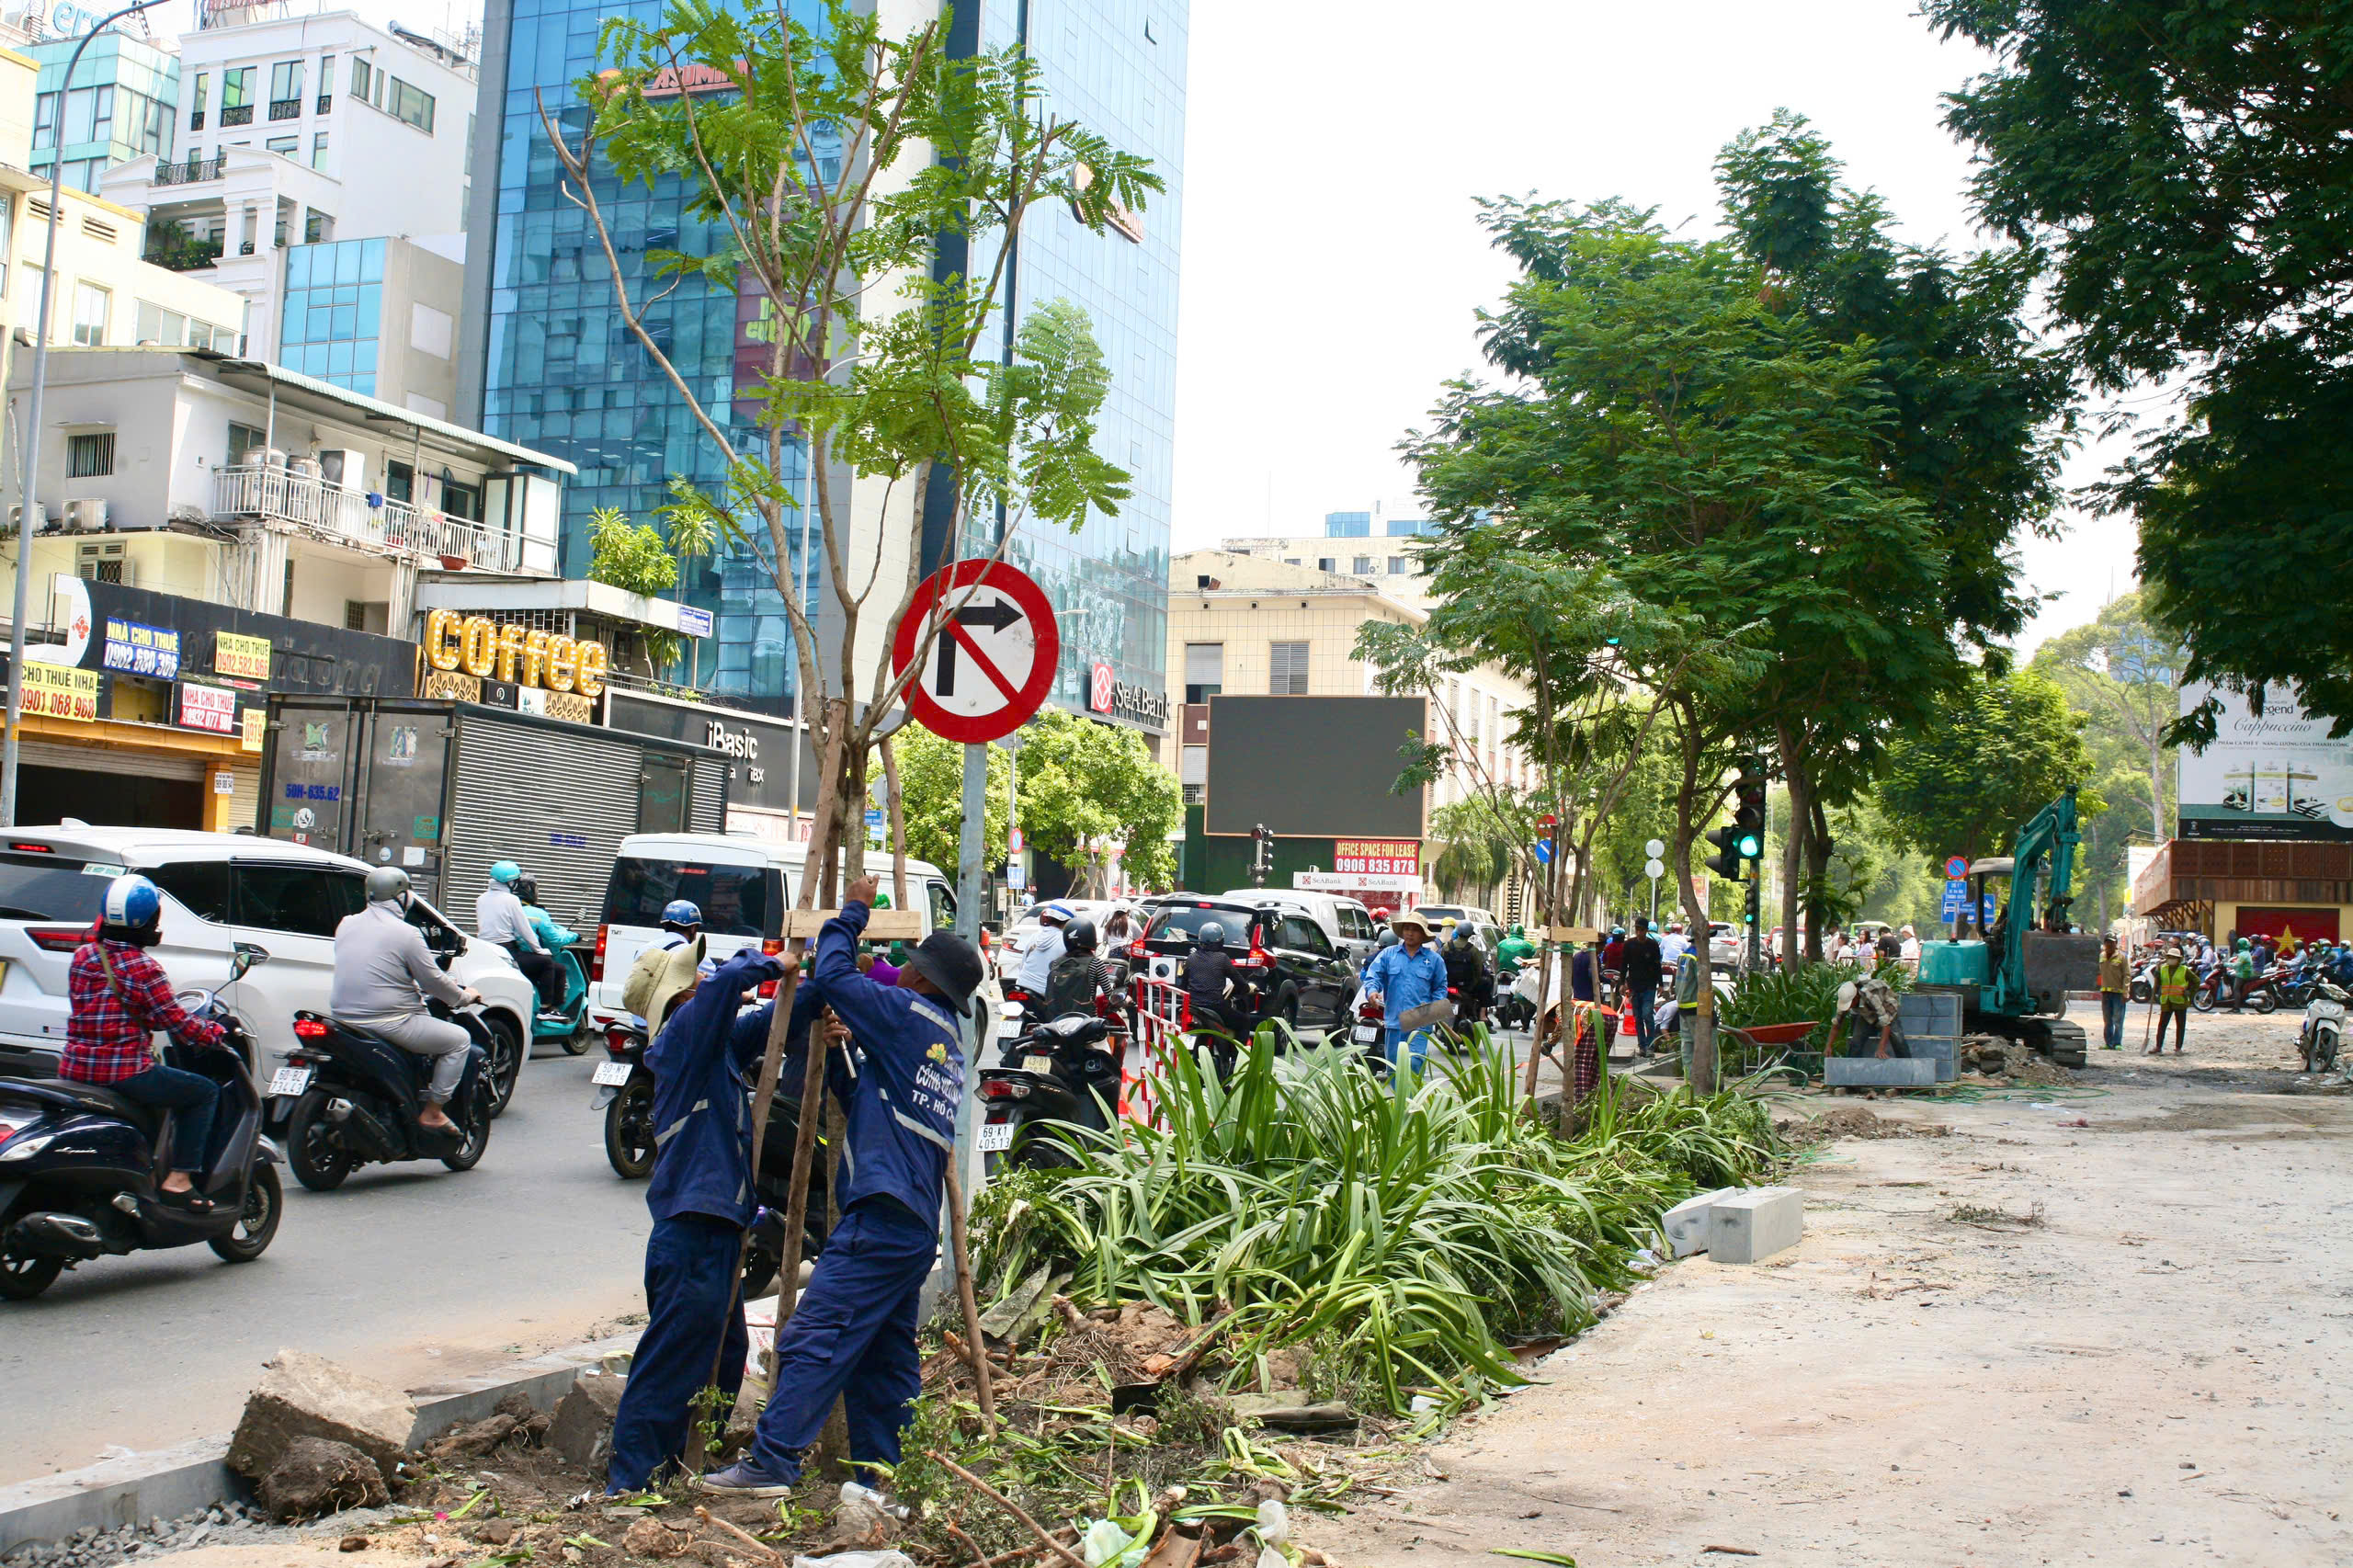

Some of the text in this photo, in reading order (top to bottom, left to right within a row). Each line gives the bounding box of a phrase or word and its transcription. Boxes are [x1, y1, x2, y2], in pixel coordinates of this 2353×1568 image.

[107, 620, 179, 652] NHÀ CHO THUÊ
[235, 640, 249, 653] CHO
[426, 609, 607, 696] Coffee
[46, 668, 71, 687] THUÊ
[50, 692, 71, 716] 068
[74, 695, 95, 720] 968
[200, 691, 215, 708] CHO
[1115, 679, 1170, 721] SeABank
[2260, 704, 2293, 715] egend
[2234, 717, 2312, 735] Cappuccino
[706, 721, 758, 759] iBasic
[748, 767, 765, 782] iBX
[1336, 843, 1415, 858] OFFICE SPACE FOR LEASE
[1336, 858, 1415, 873] 0906 835 878
[912, 1089, 930, 1108] TP.
[983, 1126, 1007, 1138] 69-K1
